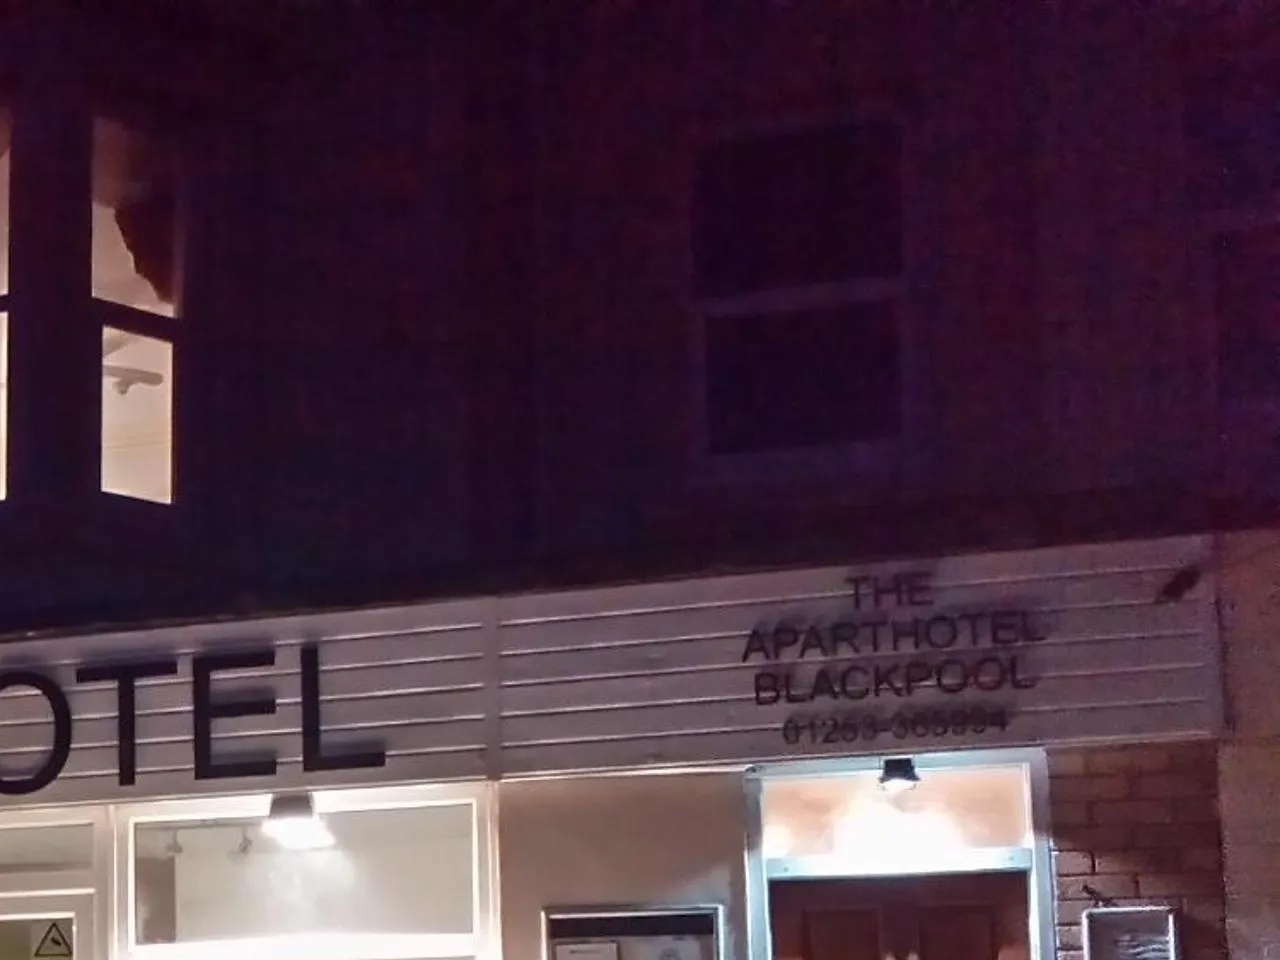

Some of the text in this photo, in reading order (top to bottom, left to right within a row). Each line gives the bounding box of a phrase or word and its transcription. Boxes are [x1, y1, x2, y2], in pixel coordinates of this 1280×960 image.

[847, 574, 933, 608] THE
[743, 609, 1046, 662] APARTHOTEL
[754, 656, 1036, 706] BLACKPOOL
